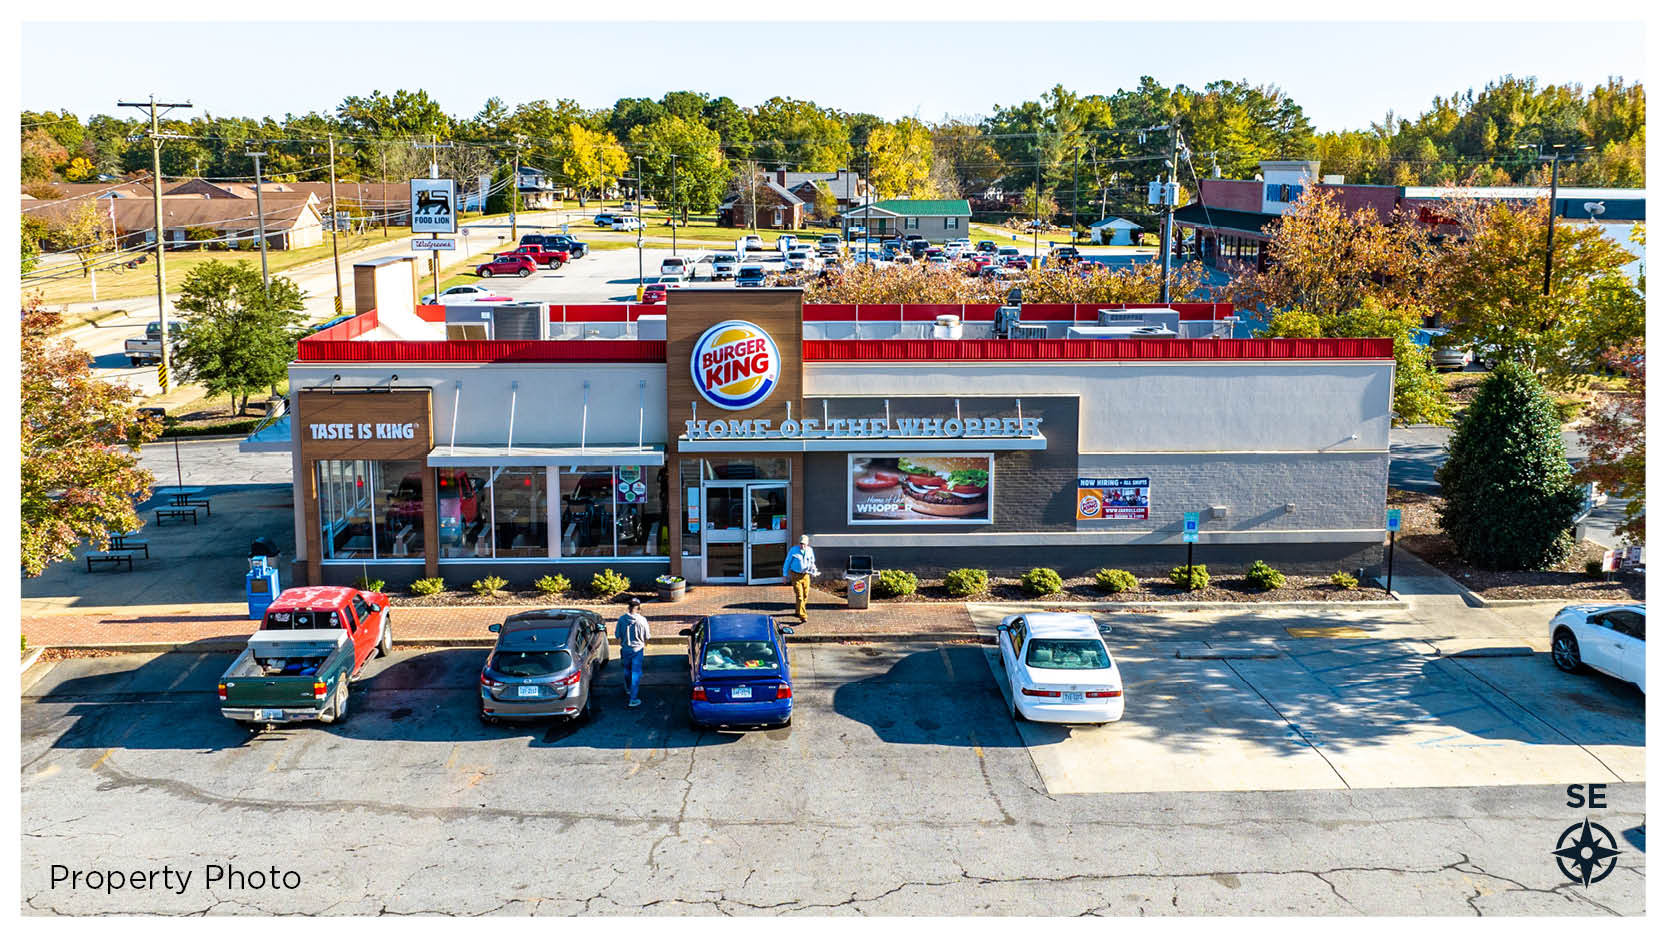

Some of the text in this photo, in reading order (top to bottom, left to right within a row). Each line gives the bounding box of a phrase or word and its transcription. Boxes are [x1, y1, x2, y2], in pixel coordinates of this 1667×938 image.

[414, 216, 450, 224] FOOD LION
[702, 338, 766, 370] BURGER
[705, 352, 769, 390] KING
[309, 423, 354, 440] TASTE
[357, 423, 373, 440] IS
[685, 418, 771, 440] HOME
[780, 418, 819, 438] OF
[828, 418, 888, 438] THE
